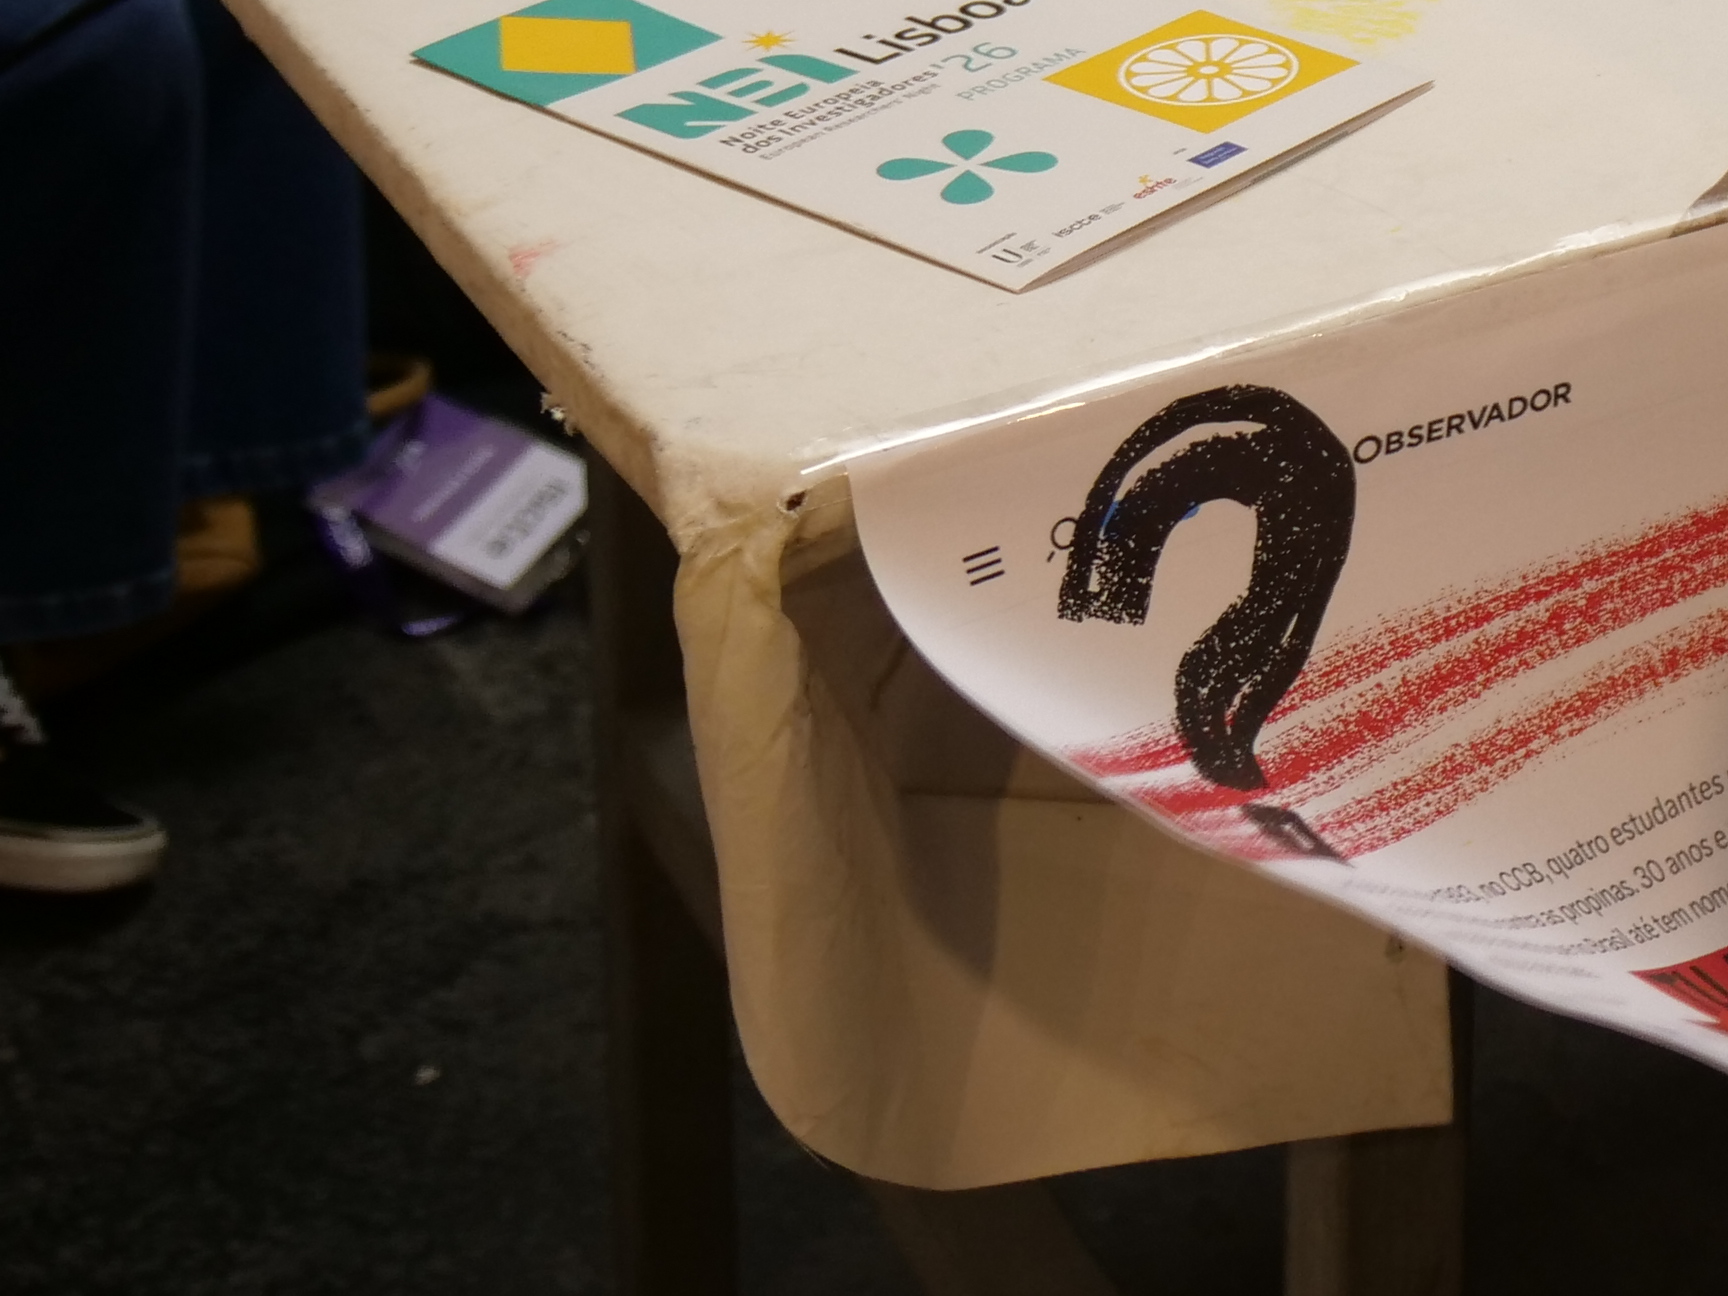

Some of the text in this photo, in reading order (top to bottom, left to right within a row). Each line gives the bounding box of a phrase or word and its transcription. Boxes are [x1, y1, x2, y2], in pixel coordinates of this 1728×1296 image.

[719, 77, 886, 148] Noite Europeia
[742, 69, 941, 155] dos Investigadores
[954, 47, 1086, 101] PROGRAMA
[1051, 212, 1102, 239] iscte
[1352, 381, 1572, 465] OBSERVADOR
[1498, 861, 1556, 892] CCB,
[1546, 834, 1611, 881] quatro
[1610, 774, 1726, 849] estudantes
[1558, 875, 1637, 928] propinas.
[1635, 858, 1665, 892] 30
[1664, 838, 1715, 878] anos
[1633, 916, 1661, 949] até
[1658, 906, 1690, 938] tem
